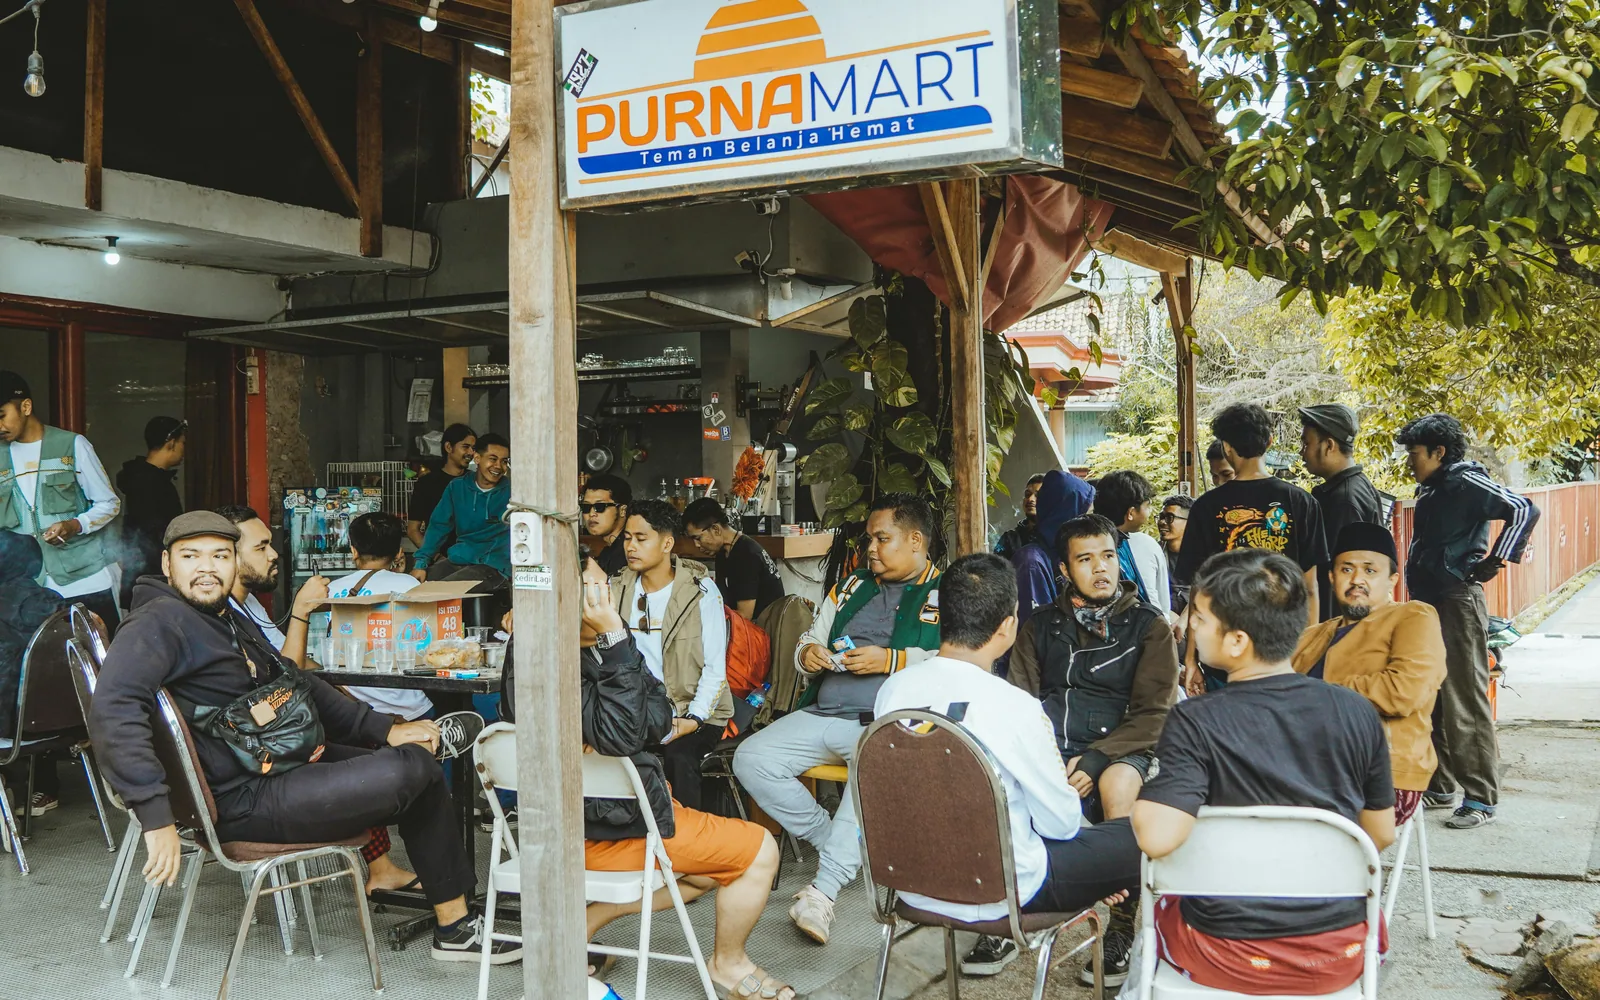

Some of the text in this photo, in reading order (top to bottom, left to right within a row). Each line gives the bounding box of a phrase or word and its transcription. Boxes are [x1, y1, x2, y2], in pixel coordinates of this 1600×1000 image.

[568, 54, 591, 89] 1927
[577, 41, 994, 153] PURNAMART
[640, 117, 915, 165] Teman Belanja Hemat
[1243, 527, 1268, 545] THE
[371, 627, 387, 638] 48
[442, 616, 456, 631] 48
